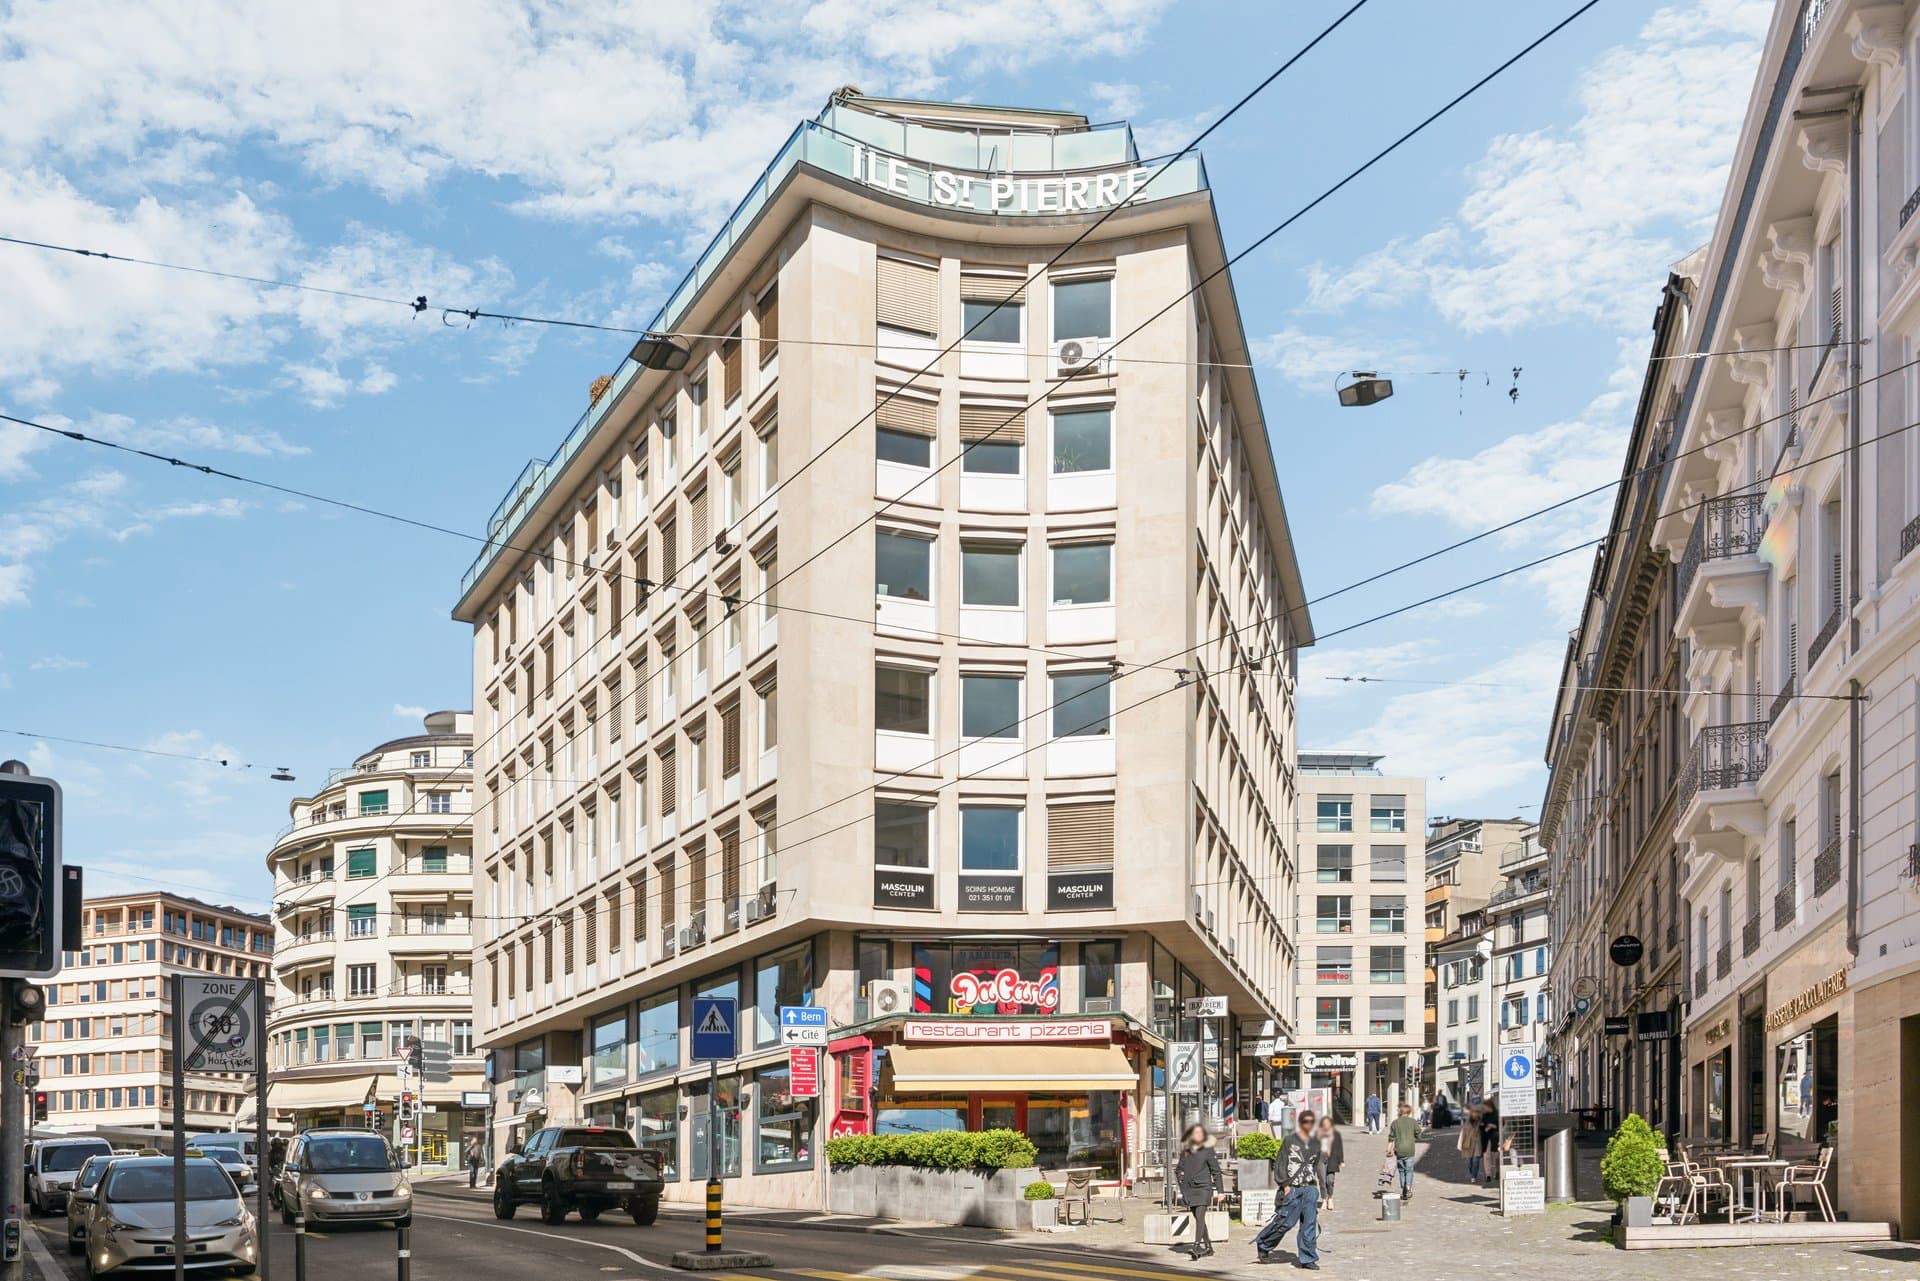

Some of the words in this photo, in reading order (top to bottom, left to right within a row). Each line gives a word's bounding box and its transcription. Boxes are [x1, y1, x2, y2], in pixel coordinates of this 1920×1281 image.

[991, 166, 1149, 212] PIERRE
[881, 882, 925, 892] MASCULIN
[1058, 884, 1103, 894] MASCULIN
[890, 890, 916, 898] CENTER
[202, 983, 237, 995] ZONE
[801, 1011, 822, 1022] Bern
[801, 1029, 820, 1040] Cité
[911, 1024, 1021, 1037] restaurant
[1029, 1023, 1105, 1039] pizzeria
[1180, 1062, 1190, 1073] 30
